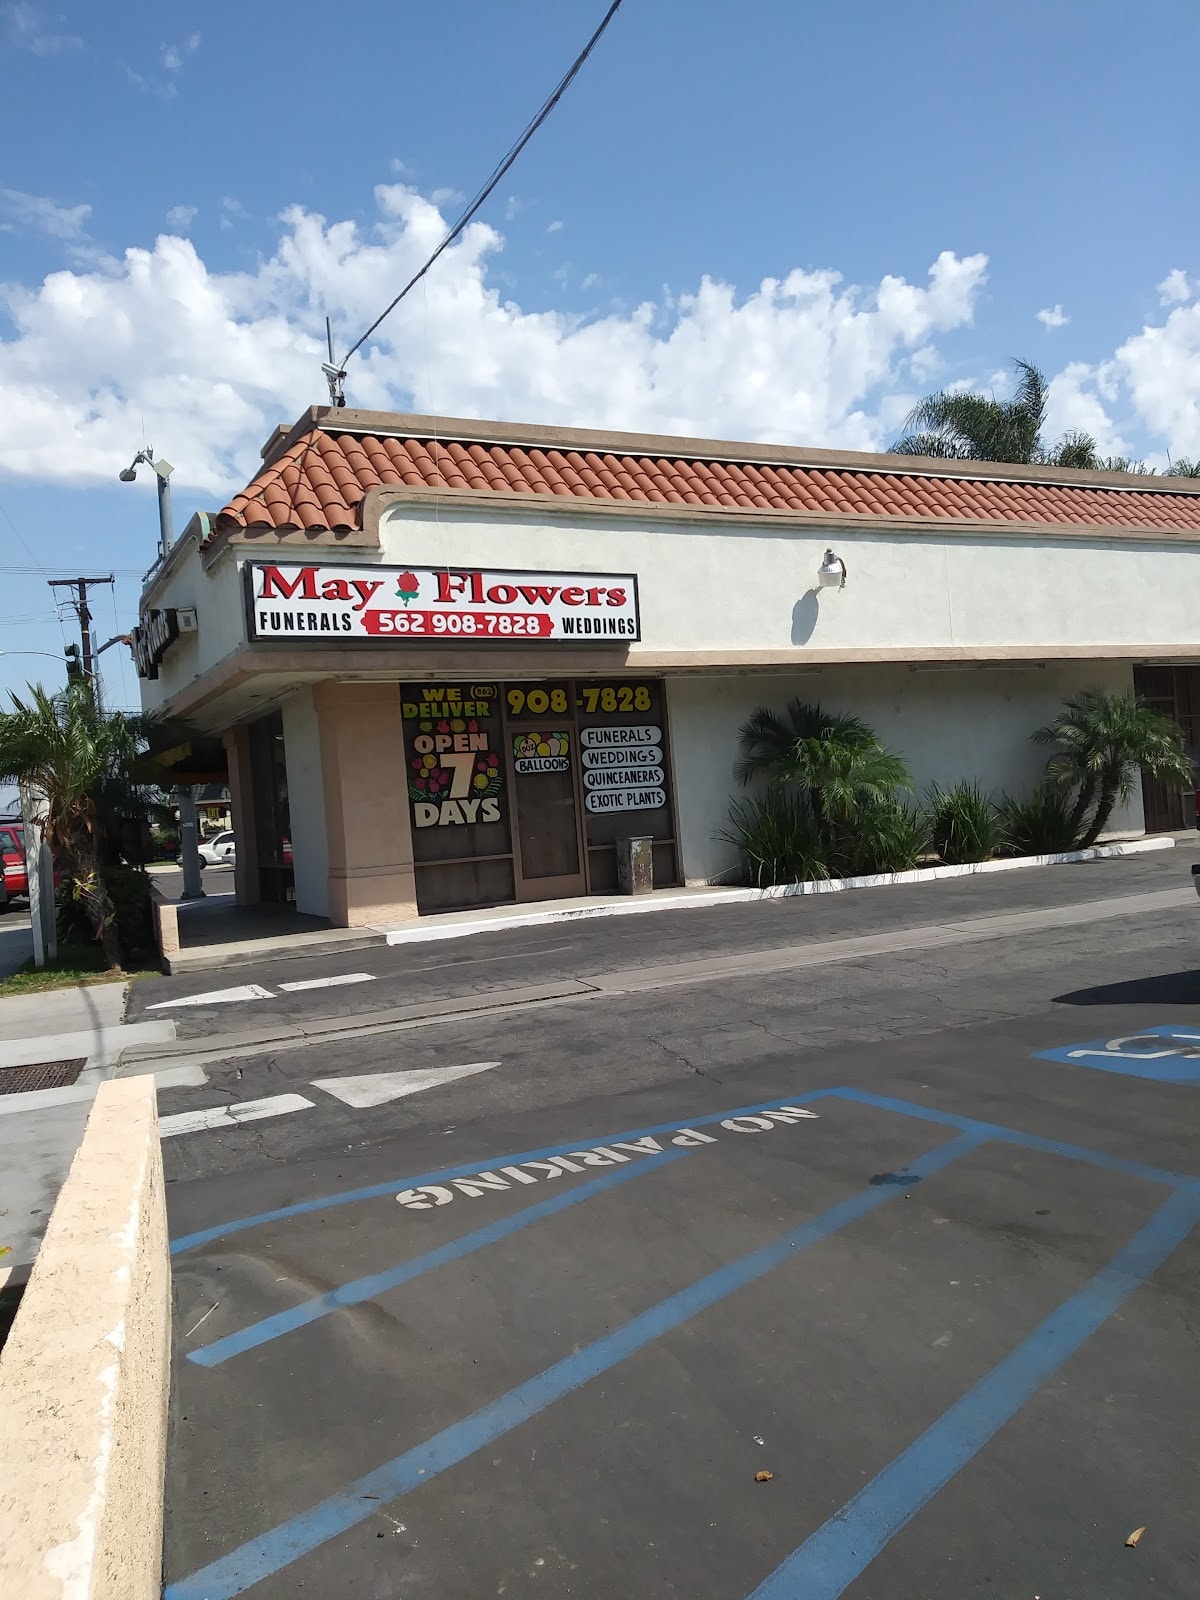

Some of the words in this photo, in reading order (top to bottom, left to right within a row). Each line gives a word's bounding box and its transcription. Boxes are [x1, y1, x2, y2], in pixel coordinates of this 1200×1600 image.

[255, 565, 384, 611] May
[432, 571, 628, 607] Flowers
[260, 611, 352, 631] FUNERALS
[378, 613, 425, 634] 562
[432, 614, 540, 635] 908-7828
[562, 617, 636, 635] WEDDINGS
[403, 701, 490, 719] DELIVER
[423, 689, 462, 701] WE
[507, 688, 568, 715] 908
[414, 732, 489, 754] OPEN
[587, 728, 652, 745] FUNERALS
[518, 758, 570, 773] BALLOONS
[587, 749, 656, 766] WEDDINGS
[439, 752, 476, 799] 7
[587, 769, 661, 786] QUINCEANERAS
[590, 791, 624, 809] EXOTIC
[626, 789, 663, 807] PLANTS
[414, 797, 501, 828] DAYS
[719, 1106, 822, 1134] NO
